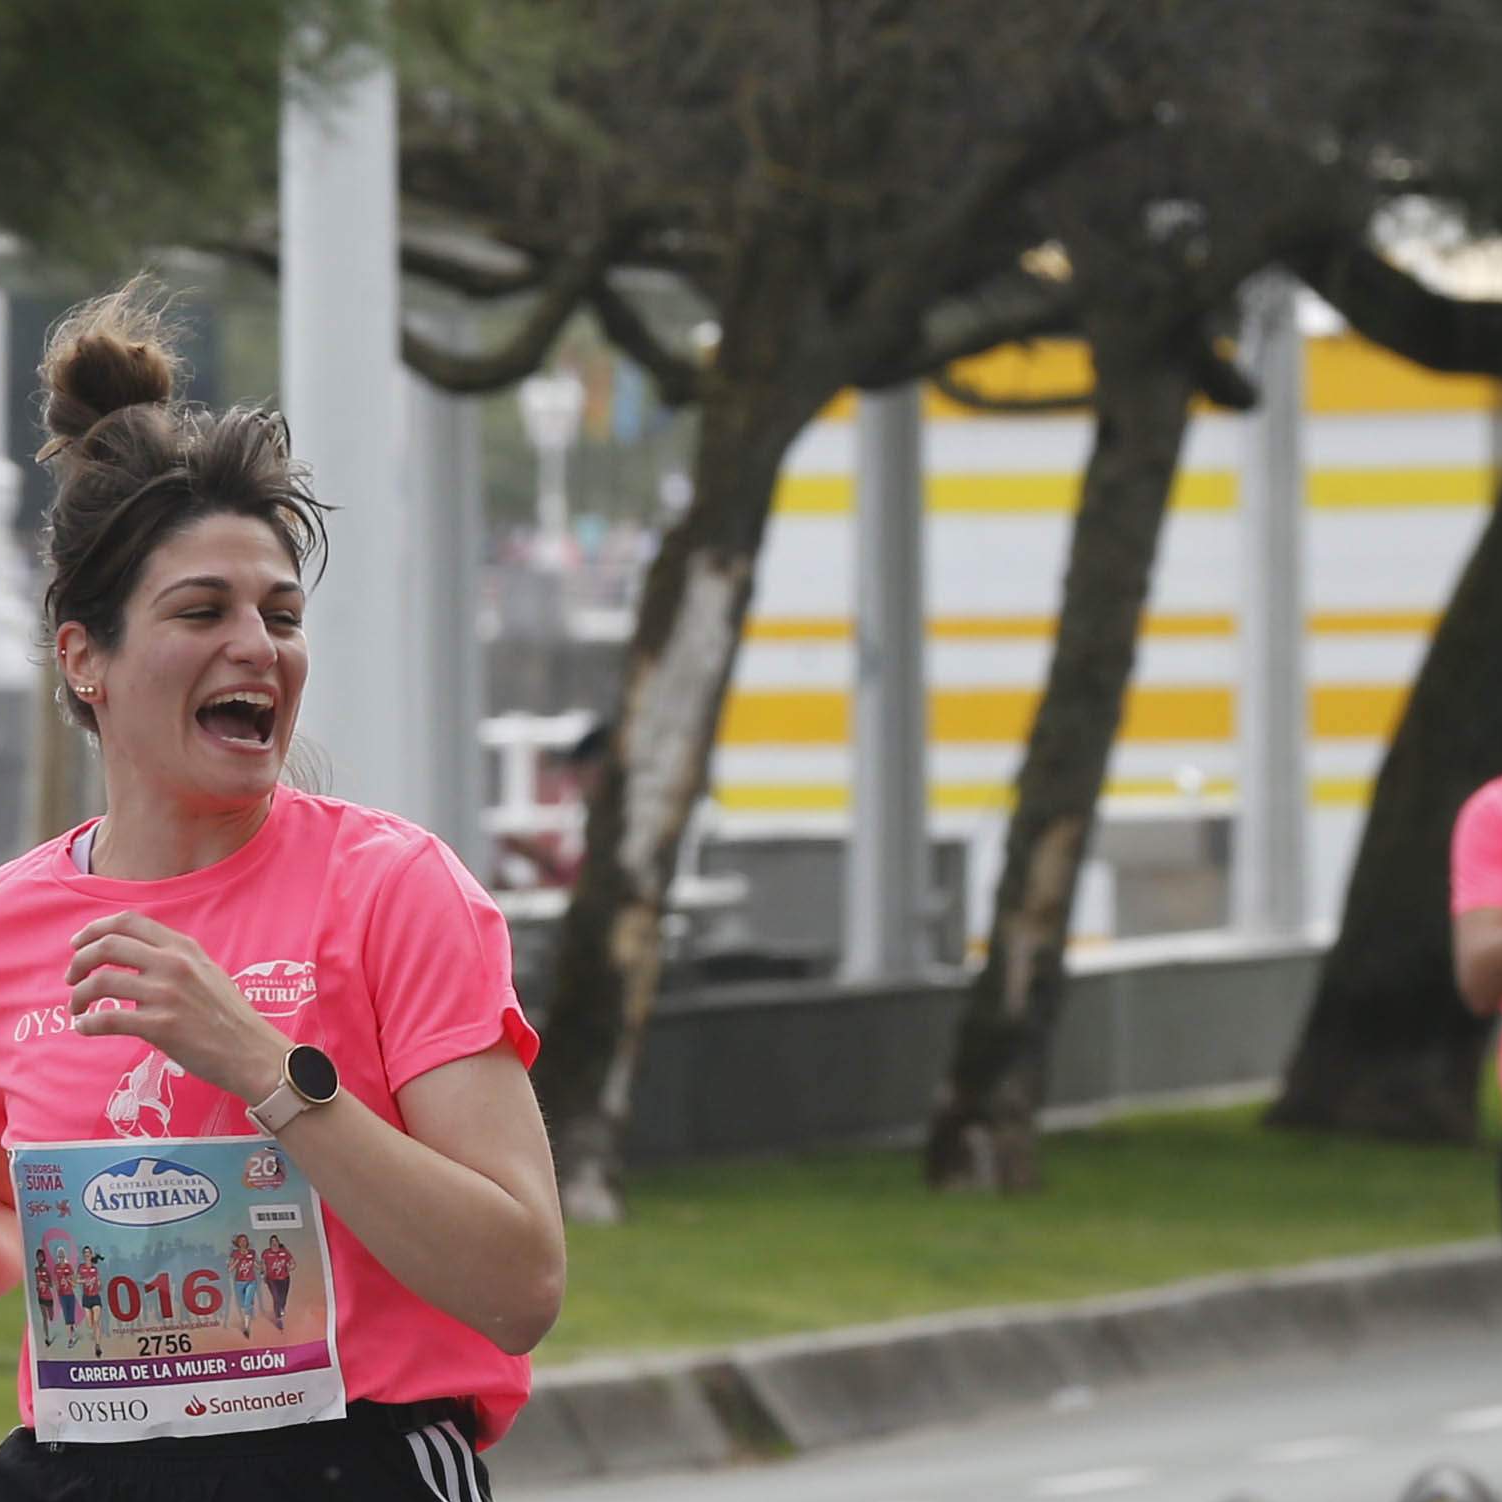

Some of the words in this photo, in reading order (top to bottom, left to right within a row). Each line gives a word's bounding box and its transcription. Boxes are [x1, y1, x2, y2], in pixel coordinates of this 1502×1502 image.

[248, 1155, 278, 1178] 20
[25, 1174, 64, 1191] SUMA
[109, 1180, 153, 1190] CENTRAL
[92, 1184, 211, 1211] ASTURIANA
[107, 1269, 224, 1323] 016
[137, 1333, 192, 1357] 2756
[69, 1366, 128, 1383] CARRERA
[131, 1365, 150, 1380] DE
[153, 1364, 173, 1379] LA
[175, 1358, 228, 1377] MUJER
[240, 1350, 285, 1371] GIJÓN
[68, 1399, 148, 1423] OYSHO
[208, 1390, 306, 1415] Santander
